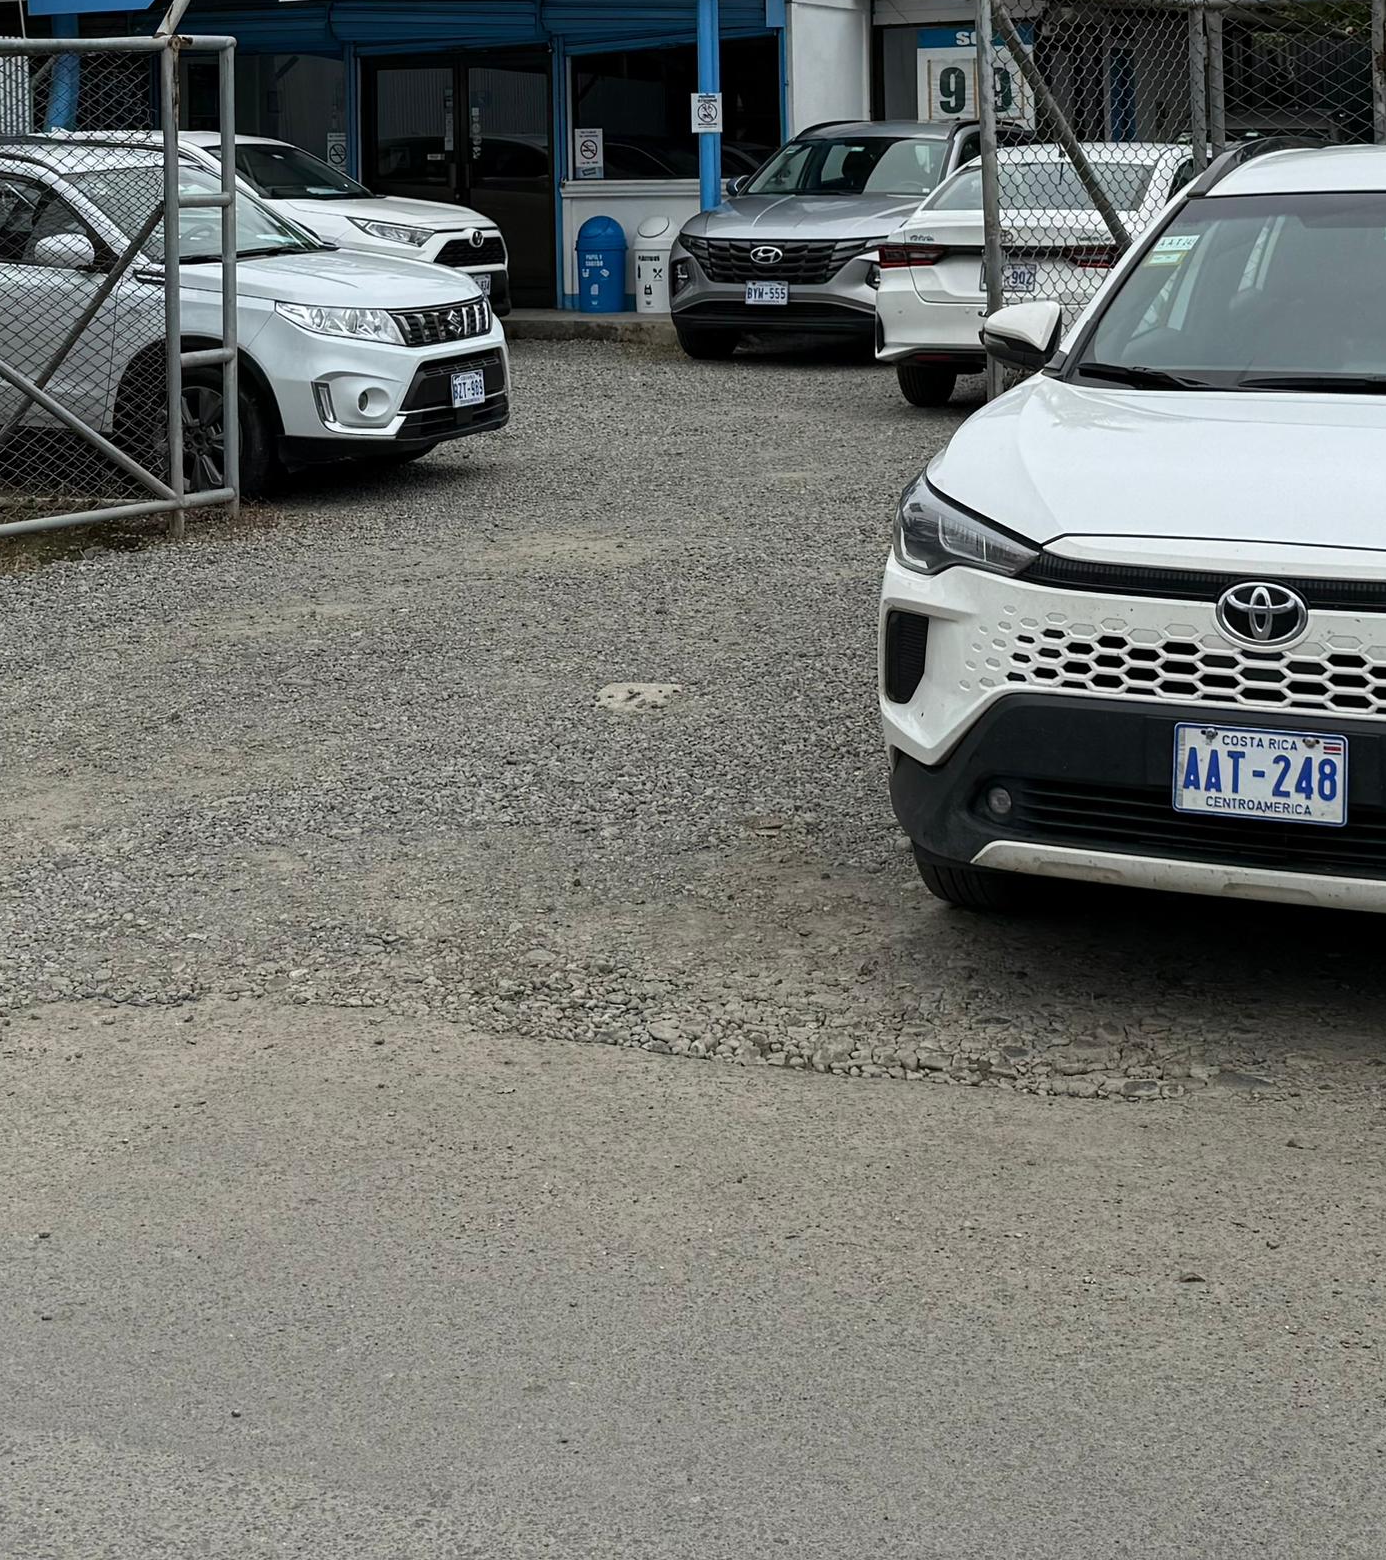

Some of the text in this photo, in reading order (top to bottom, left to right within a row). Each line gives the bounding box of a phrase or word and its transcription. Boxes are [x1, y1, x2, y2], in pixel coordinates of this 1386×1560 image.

[1222, 735, 1298, 752] COSTA RICA
[1183, 746, 1337, 801] AAT-248
[1205, 796, 1312, 815] CENTROAMERICA
